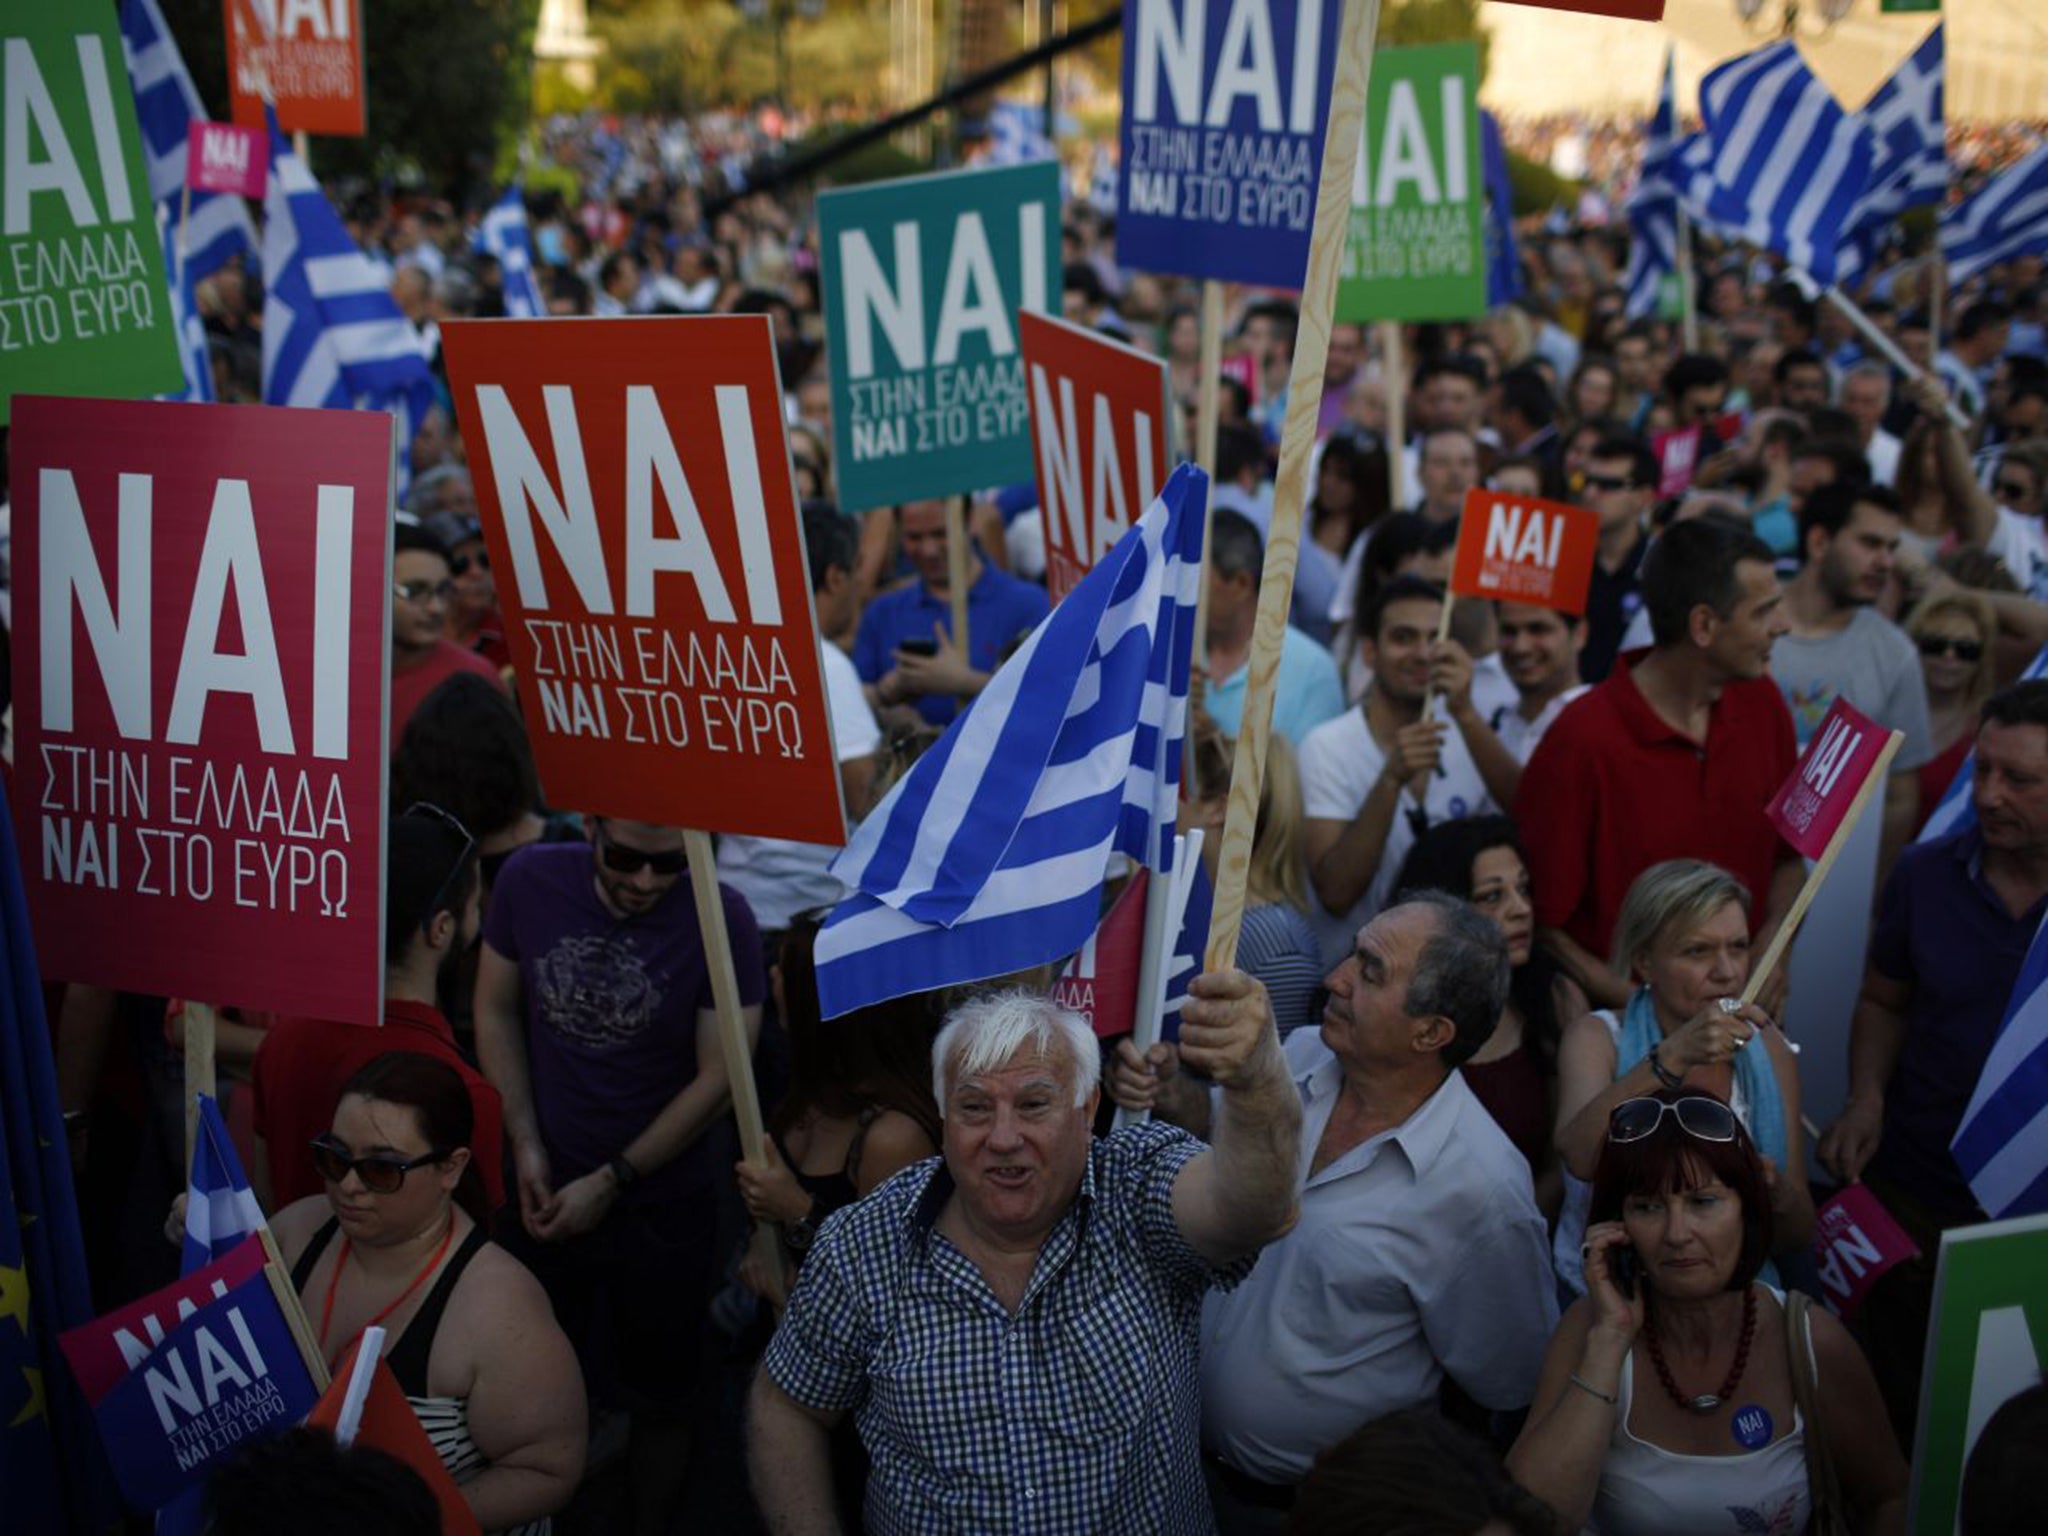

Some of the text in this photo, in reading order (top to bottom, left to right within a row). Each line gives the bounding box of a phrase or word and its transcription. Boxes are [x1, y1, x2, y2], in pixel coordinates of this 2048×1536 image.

[1133, 0, 1322, 134] ΝΑΙ
[4, 33, 135, 235] ΑΙ
[202, 128, 249, 173] ΝΑΙ
[1132, 126, 1313, 184] ΣΤΗΝ ΕΛΛΑΔΑ
[1129, 171, 1178, 217] ΝΑΙ
[1182, 174, 1233, 223] ΣΤΟ
[1237, 180, 1311, 231] ΕΥΡΩ
[10, 230, 148, 293] ΕΛΛΑΔΑ
[839, 202, 1046, 379] ΝΑΙ
[0, 280, 155, 350] ΣΤΟ ΕΥΡΩ
[850, 357, 1026, 422] ΣΤΗΝ ΕΛΛΑΔ
[852, 400, 1028, 462] ΝΑΙ ΣΤΟ ΕΥΡ
[1031, 362, 1155, 567] ΝΑΙ
[475, 384, 783, 626] ΝΑΙ
[1484, 502, 1566, 570] ΝΑΙ
[38, 467, 355, 761] ΝΑΙ
[525, 619, 797, 696] ΣΤΗΝ ΕΛΛΑΔΑ
[538, 679, 805, 759] ΝΑΙ ΣΤΟ ΕΥΡΩ
[40, 743, 351, 842] ΣΤΗΝ ΕΛΛΑΔΑ
[42, 814, 348, 918] ΝΑΙ ΣΤΟ ΕΥΡΩ
[1053, 982, 1095, 1010] ΑΔΑ
[143, 1306, 269, 1436] ΝΑΙ
[168, 1377, 280, 1449] ΣΤΗΝ ΕΛΛΑΔΑ
[175, 1394, 287, 1473] ΝΑΙ ΣΤΟ ΕΥΡΩ
[1737, 1410, 1764, 1435] ΝΑΙ
